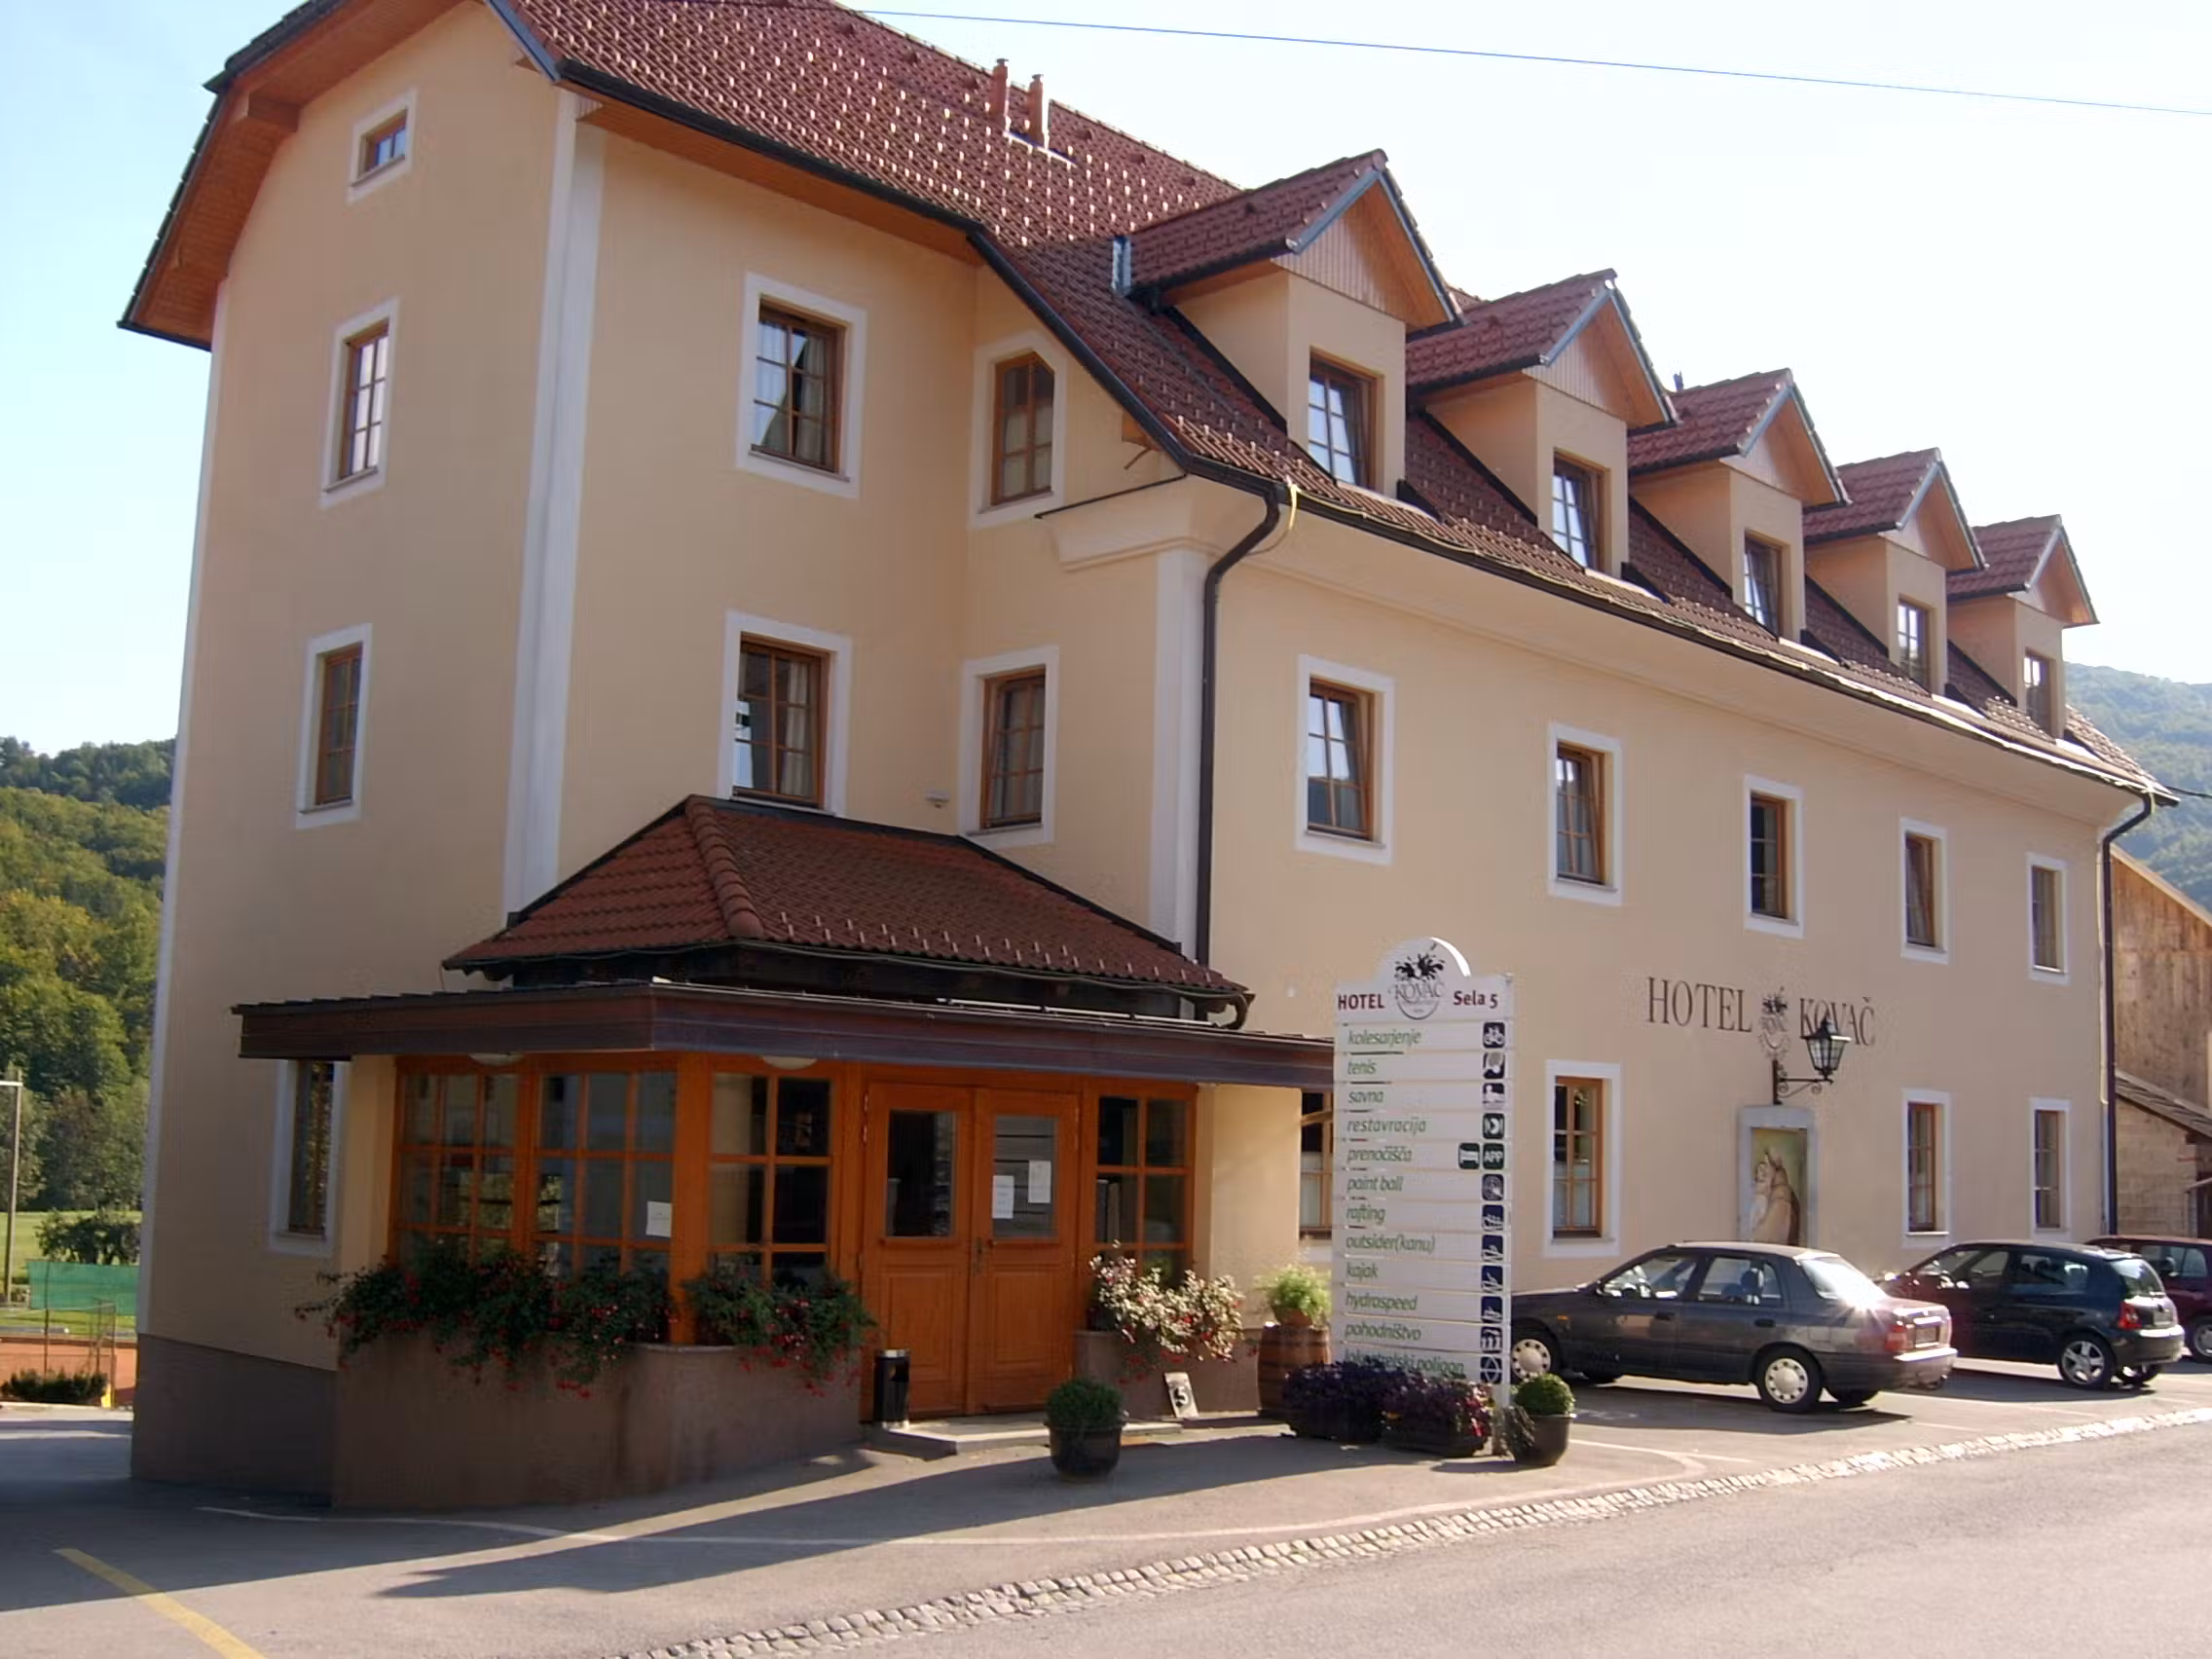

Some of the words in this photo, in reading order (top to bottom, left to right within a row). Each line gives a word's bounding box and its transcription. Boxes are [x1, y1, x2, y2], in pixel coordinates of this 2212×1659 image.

[1337, 993, 1385, 1010] HOTEL
[1453, 990, 1486, 1007] Sela
[1489, 993, 1498, 1009] 5
[1647, 977, 1751, 1033] HOTEL
[1799, 995, 1875, 1047] KOVAČ
[1347, 1028, 1421, 1048] kolesarjenje
[1346, 1058, 1377, 1076] tenis
[1347, 1089, 1384, 1104] savna
[1346, 1117, 1426, 1137] restavracija
[1484, 1150, 1503, 1163] APP
[1346, 1175, 1379, 1193] paint
[1380, 1175, 1404, 1192] ball
[1346, 1204, 1386, 1225] rafting
[1346, 1262, 1379, 1281] kajak
[1346, 1292, 1419, 1313] hydrospeed
